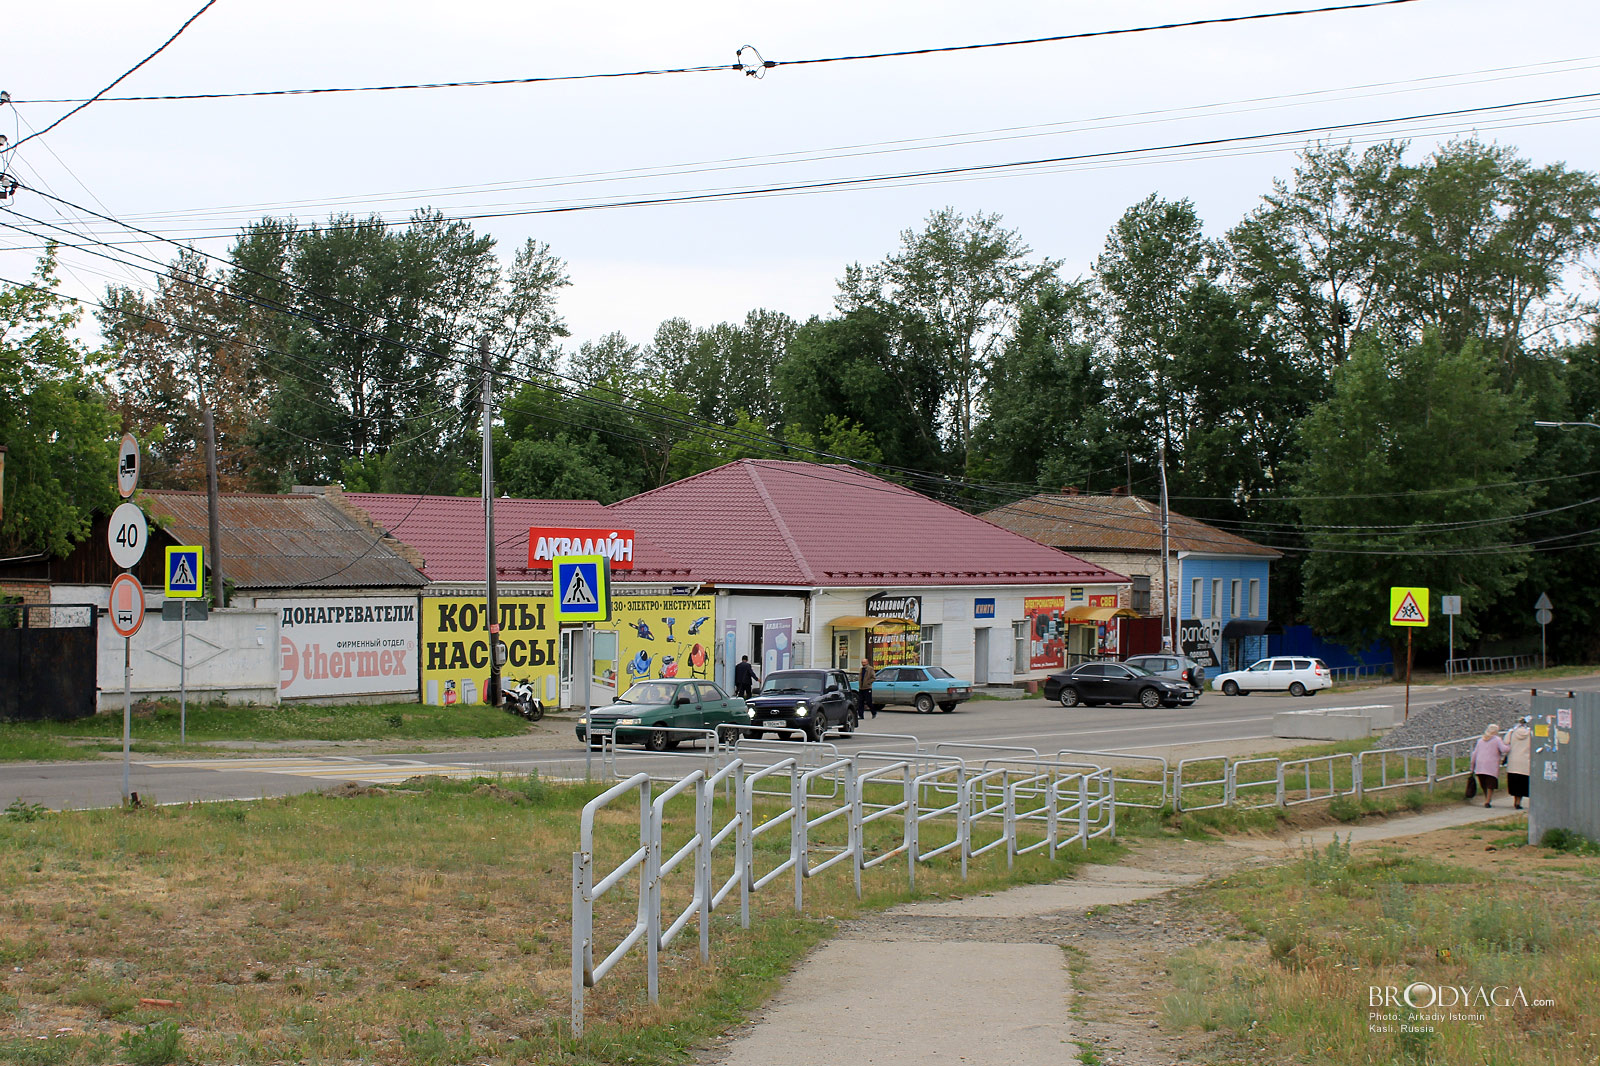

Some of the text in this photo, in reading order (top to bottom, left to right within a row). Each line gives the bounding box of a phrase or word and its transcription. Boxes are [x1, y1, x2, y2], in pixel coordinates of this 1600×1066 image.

[116, 523, 138, 548] 40
[533, 532, 633, 562] АКВАЛАЙН
[663, 600, 711, 611] ИНСТРУМЕНТ
[1100, 596, 1115, 607] СВЕТ
[281, 605, 415, 628] ДОНАГРЕВАТЕЛИ
[438, 603, 546, 632] КОТЛЫ
[337, 639, 405, 649] ФИРМЕННЫЙ ОТДЕЛ
[1181, 625, 1210, 647] panda
[302, 643, 407, 681] thermex
